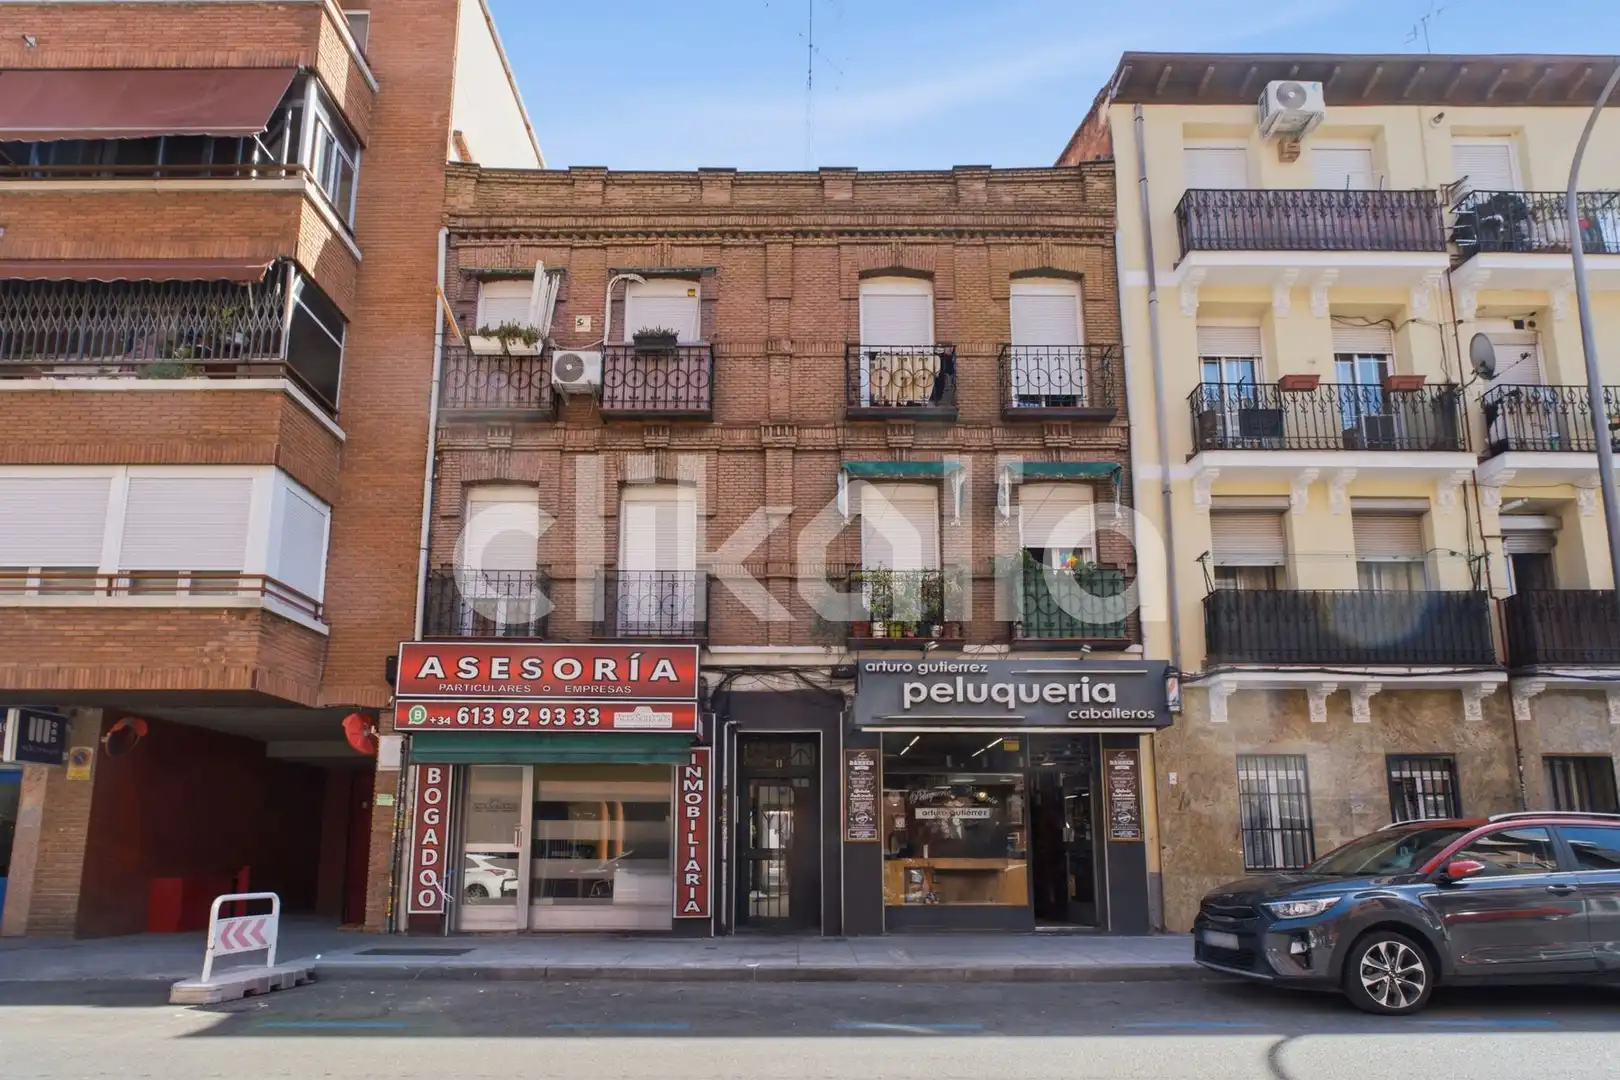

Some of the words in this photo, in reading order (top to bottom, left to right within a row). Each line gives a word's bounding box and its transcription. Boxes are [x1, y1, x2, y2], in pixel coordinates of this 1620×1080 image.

[416, 652, 679, 681] ASESORÍA
[865, 661, 913, 672] arturo
[917, 661, 988, 675] gutierrez
[438, 683, 531, 693] PARTICULARES
[564, 685, 632, 694] EMPRESAS
[903, 676, 1116, 709] peluqueria
[429, 716, 451, 725] +34
[456, 706, 495, 725] 613
[502, 707, 529, 725] 92
[538, 707, 566, 726] 93
[573, 708, 600, 726] 33
[1068, 707, 1155, 719] caballeros
[683, 753, 704, 913] INMOBILIARIA
